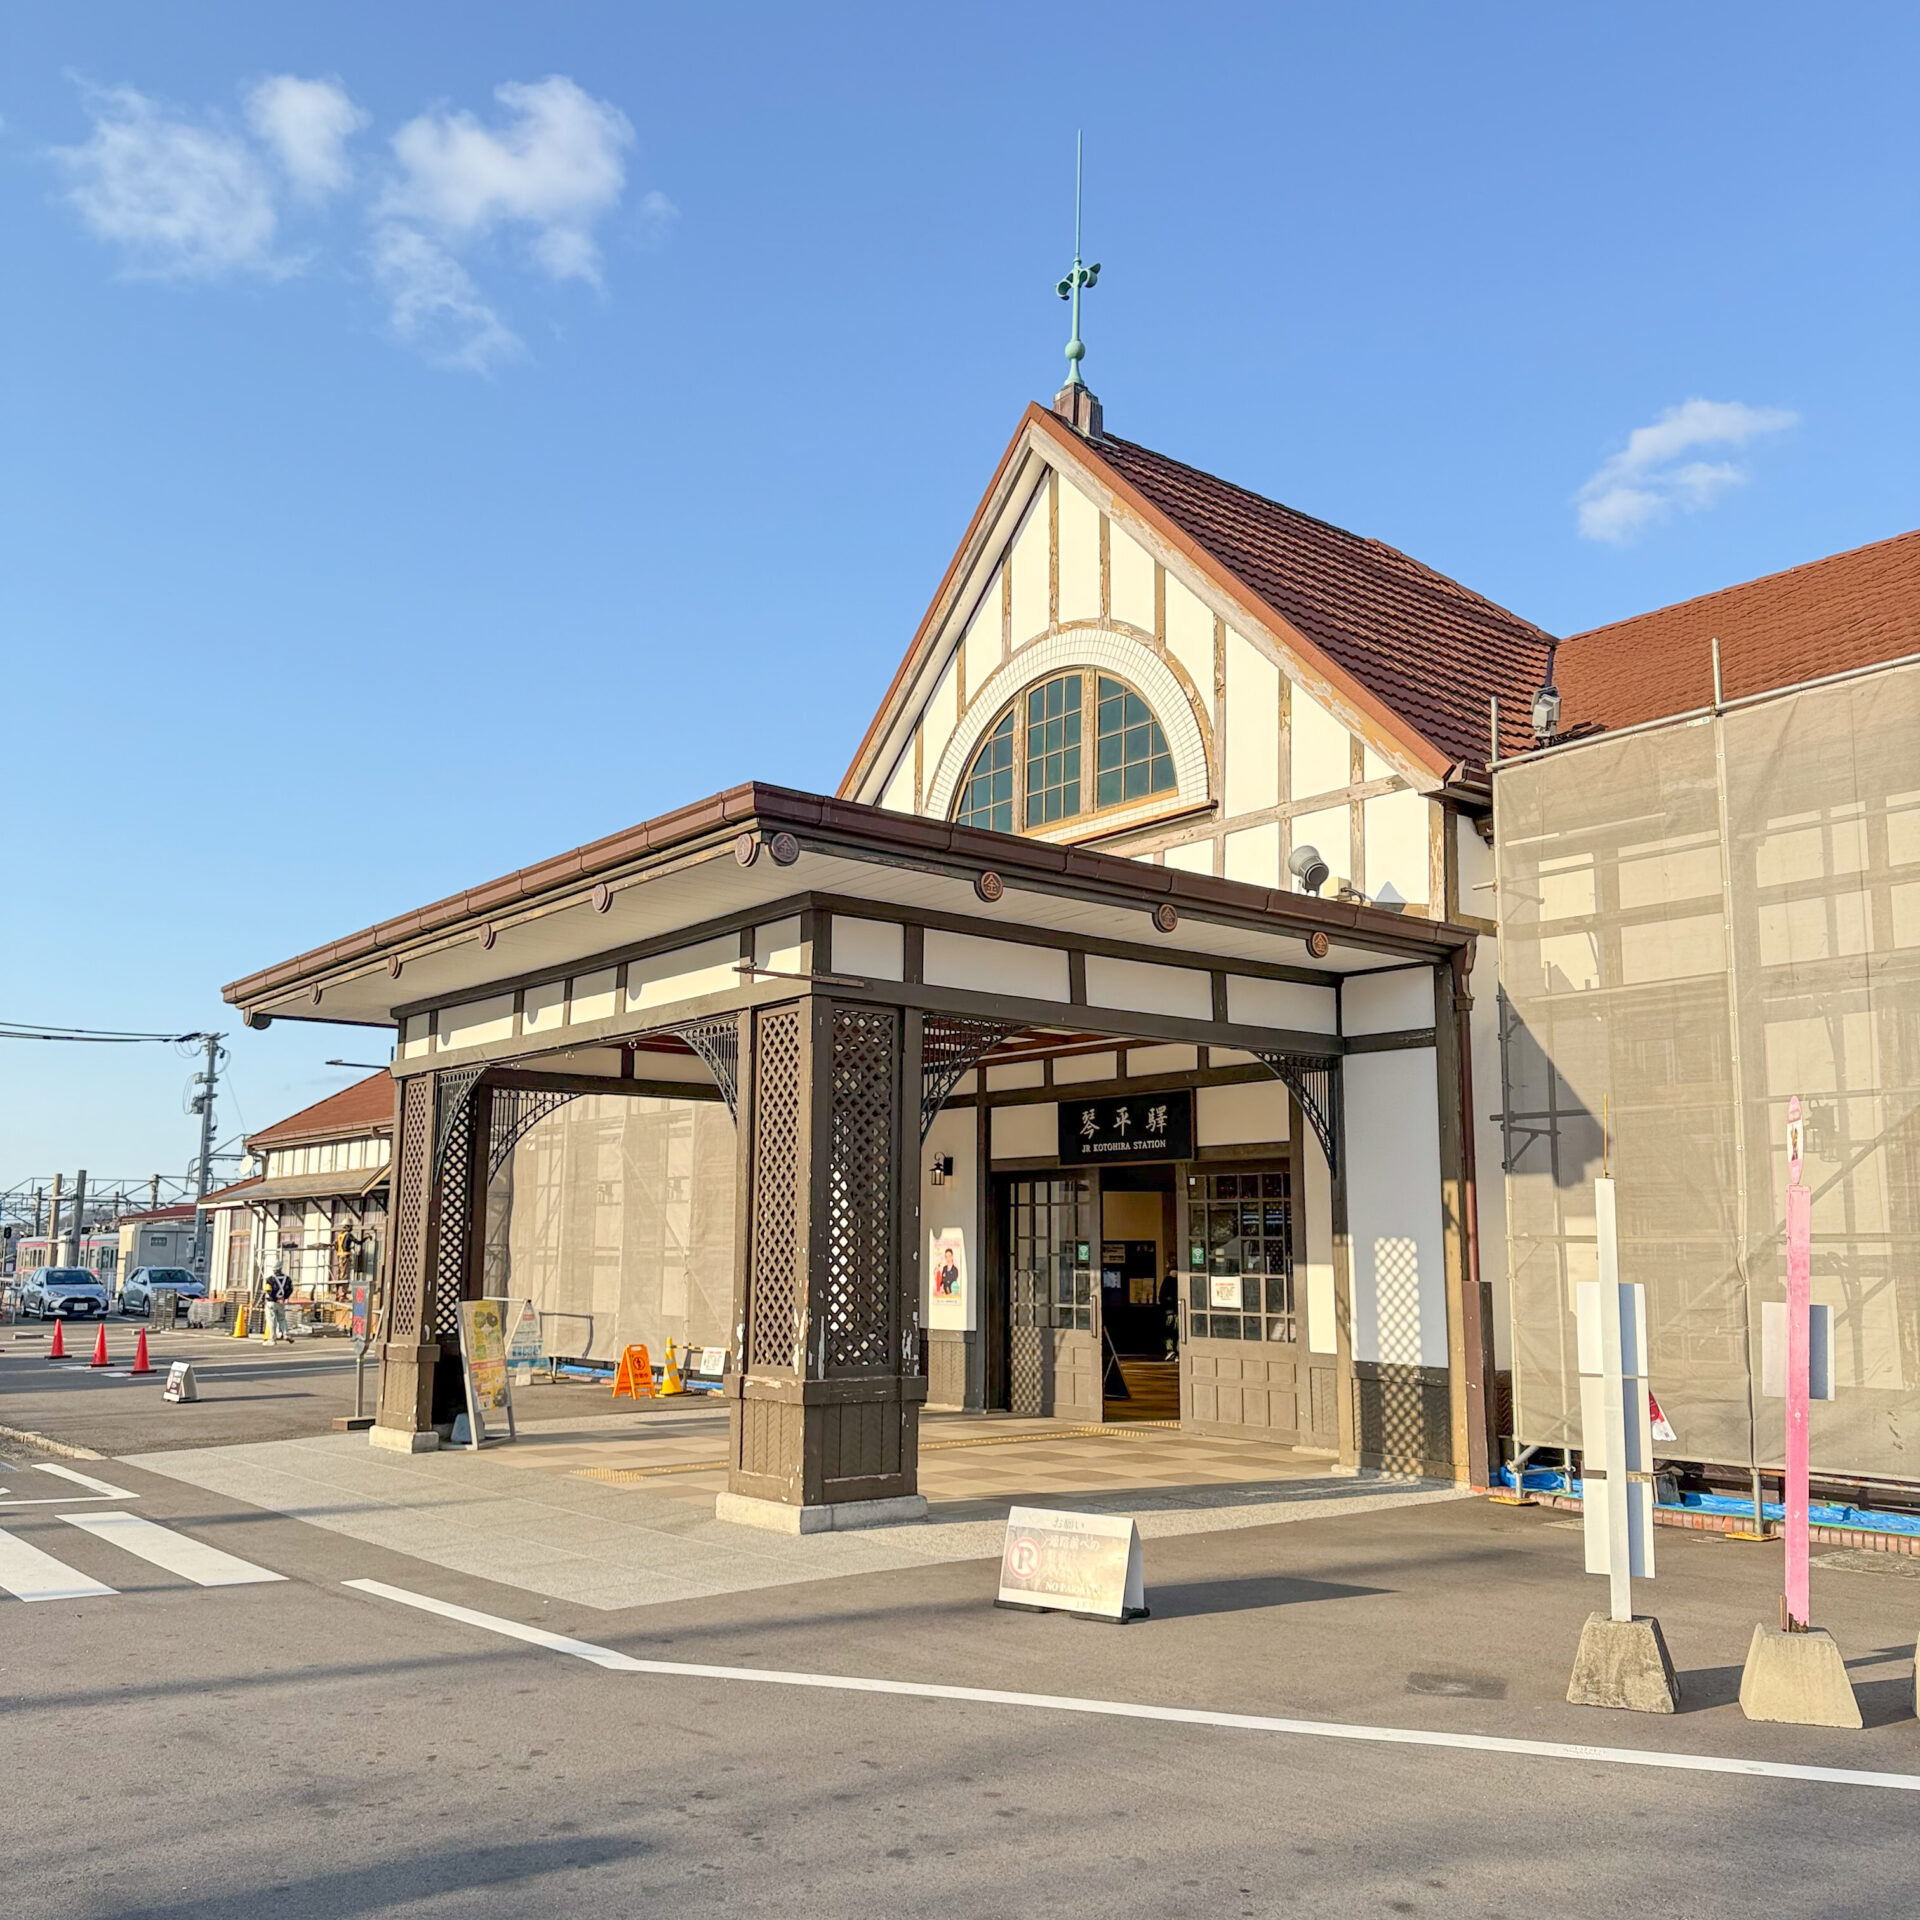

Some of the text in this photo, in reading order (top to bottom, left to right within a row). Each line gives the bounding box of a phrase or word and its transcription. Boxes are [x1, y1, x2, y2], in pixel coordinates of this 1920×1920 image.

[1079, 1105, 1168, 1139] 琴平驛
[1081, 1139, 1166, 1153] JR KOTOHIRA STATION
[1053, 1517, 1085, 1529] お願い
[1045, 1582, 1058, 1591] NO
